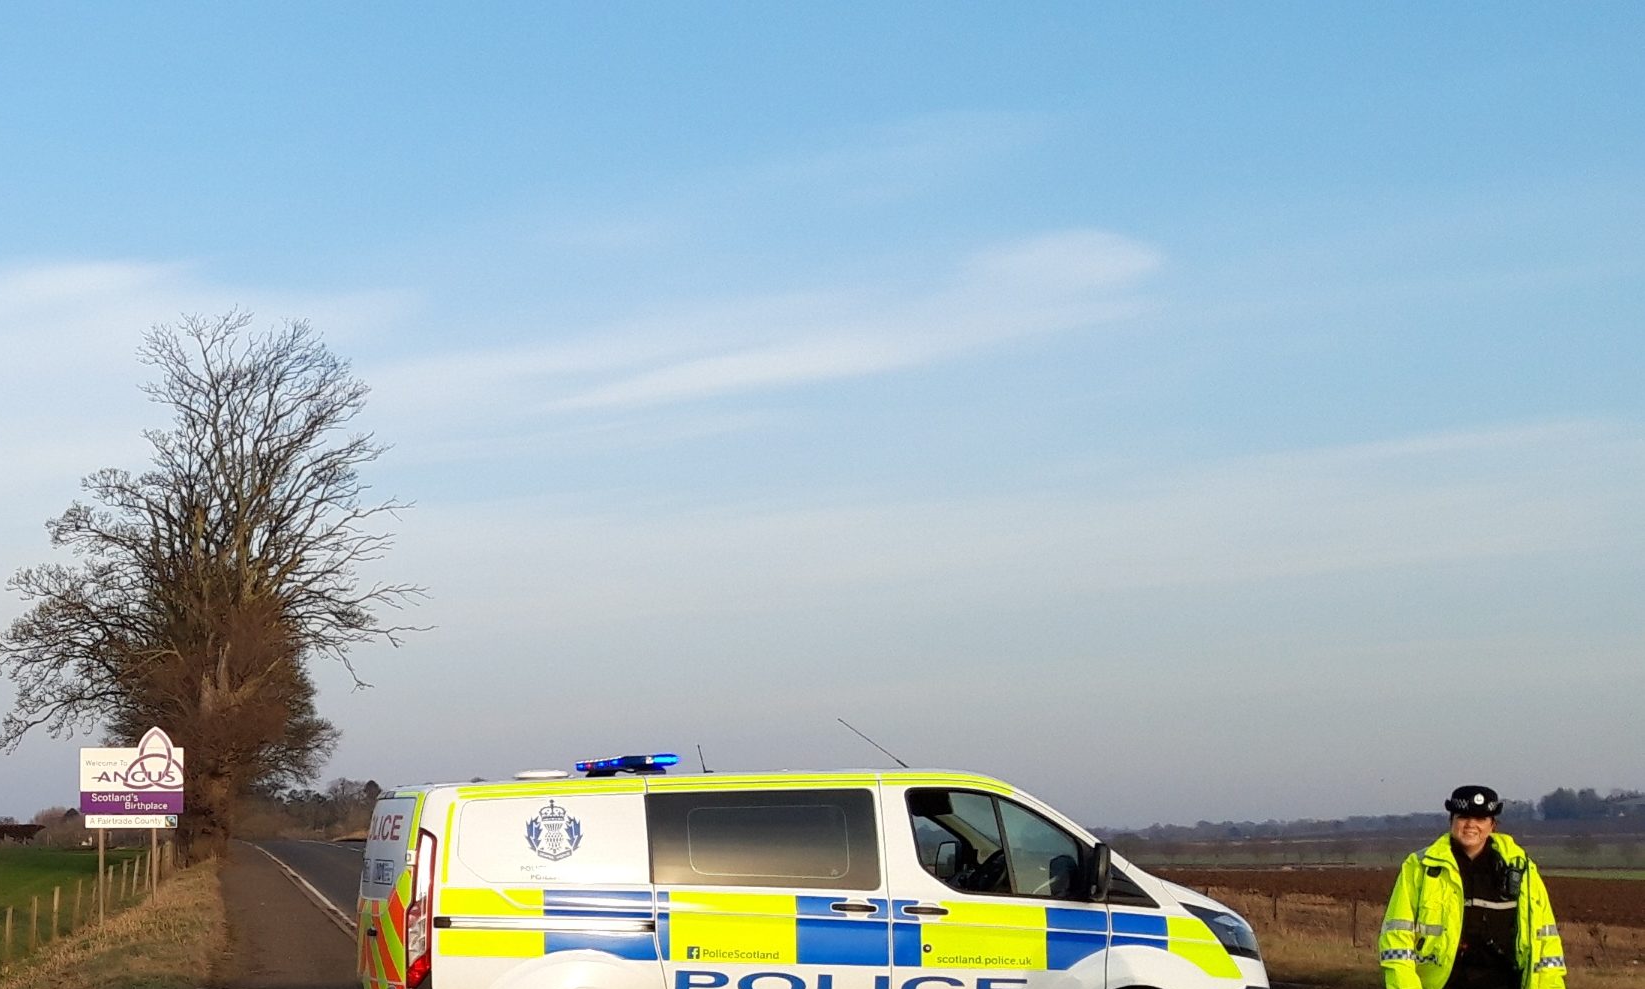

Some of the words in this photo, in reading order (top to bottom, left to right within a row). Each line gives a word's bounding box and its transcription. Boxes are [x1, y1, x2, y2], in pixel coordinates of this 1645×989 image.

[91, 771, 176, 783] ANGUS
[91, 792, 139, 802] Scotland's
[124, 801, 168, 811] Birthplace
[98, 817, 133, 825] Fairtrade
[134, 817, 163, 826] County
[702, 949, 780, 960] PoliceScotland
[937, 955, 1032, 966] scotland.police.uk
